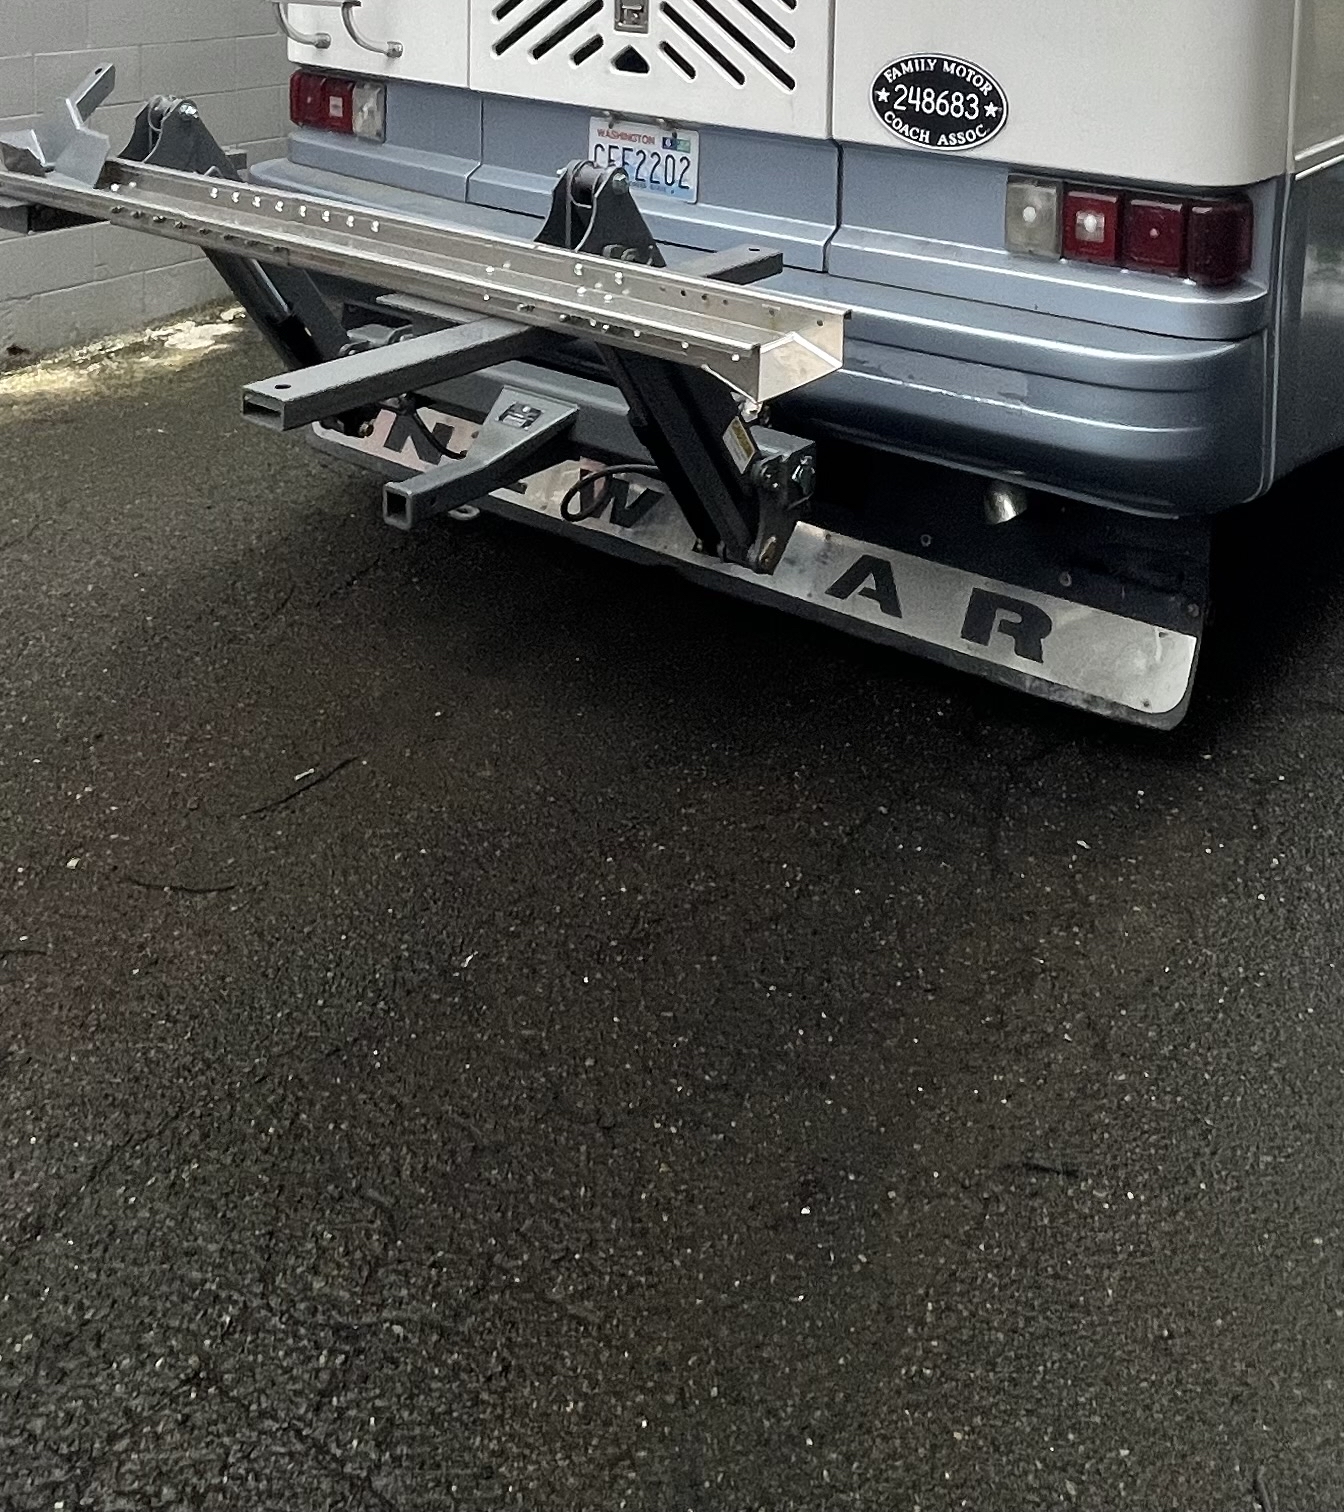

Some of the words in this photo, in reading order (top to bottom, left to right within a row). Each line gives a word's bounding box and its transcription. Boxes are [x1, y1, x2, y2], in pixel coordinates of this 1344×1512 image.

[882, 58, 937, 83] FAMILY
[942, 60, 993, 96] MOTOR
[893, 84, 980, 120] 248683
[884, 111, 930, 143] COACH
